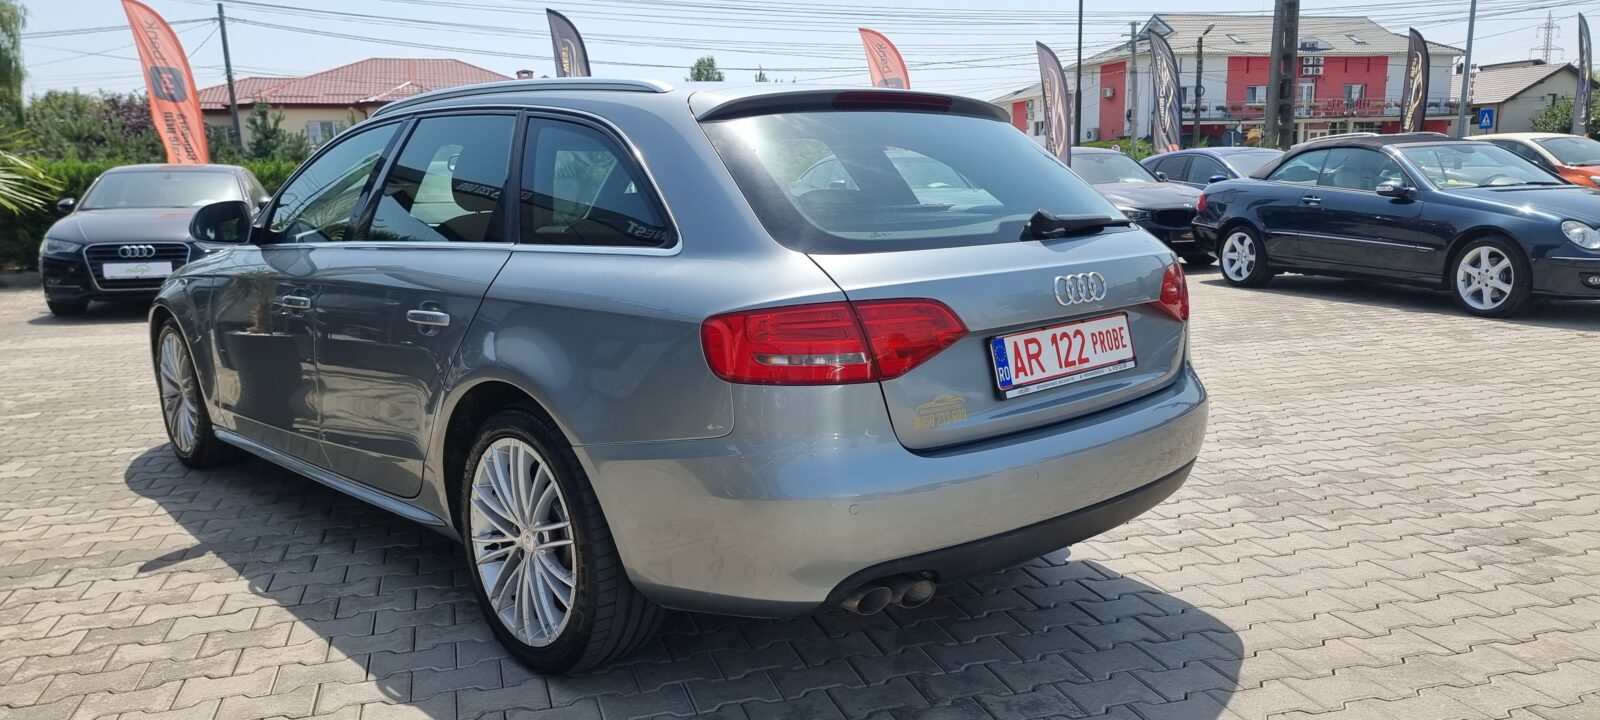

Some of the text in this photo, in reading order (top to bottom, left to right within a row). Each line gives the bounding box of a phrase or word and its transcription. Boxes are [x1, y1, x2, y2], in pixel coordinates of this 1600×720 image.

[1013, 326, 1127, 379] AR 122 PROBE
[999, 366, 1011, 382] RO
